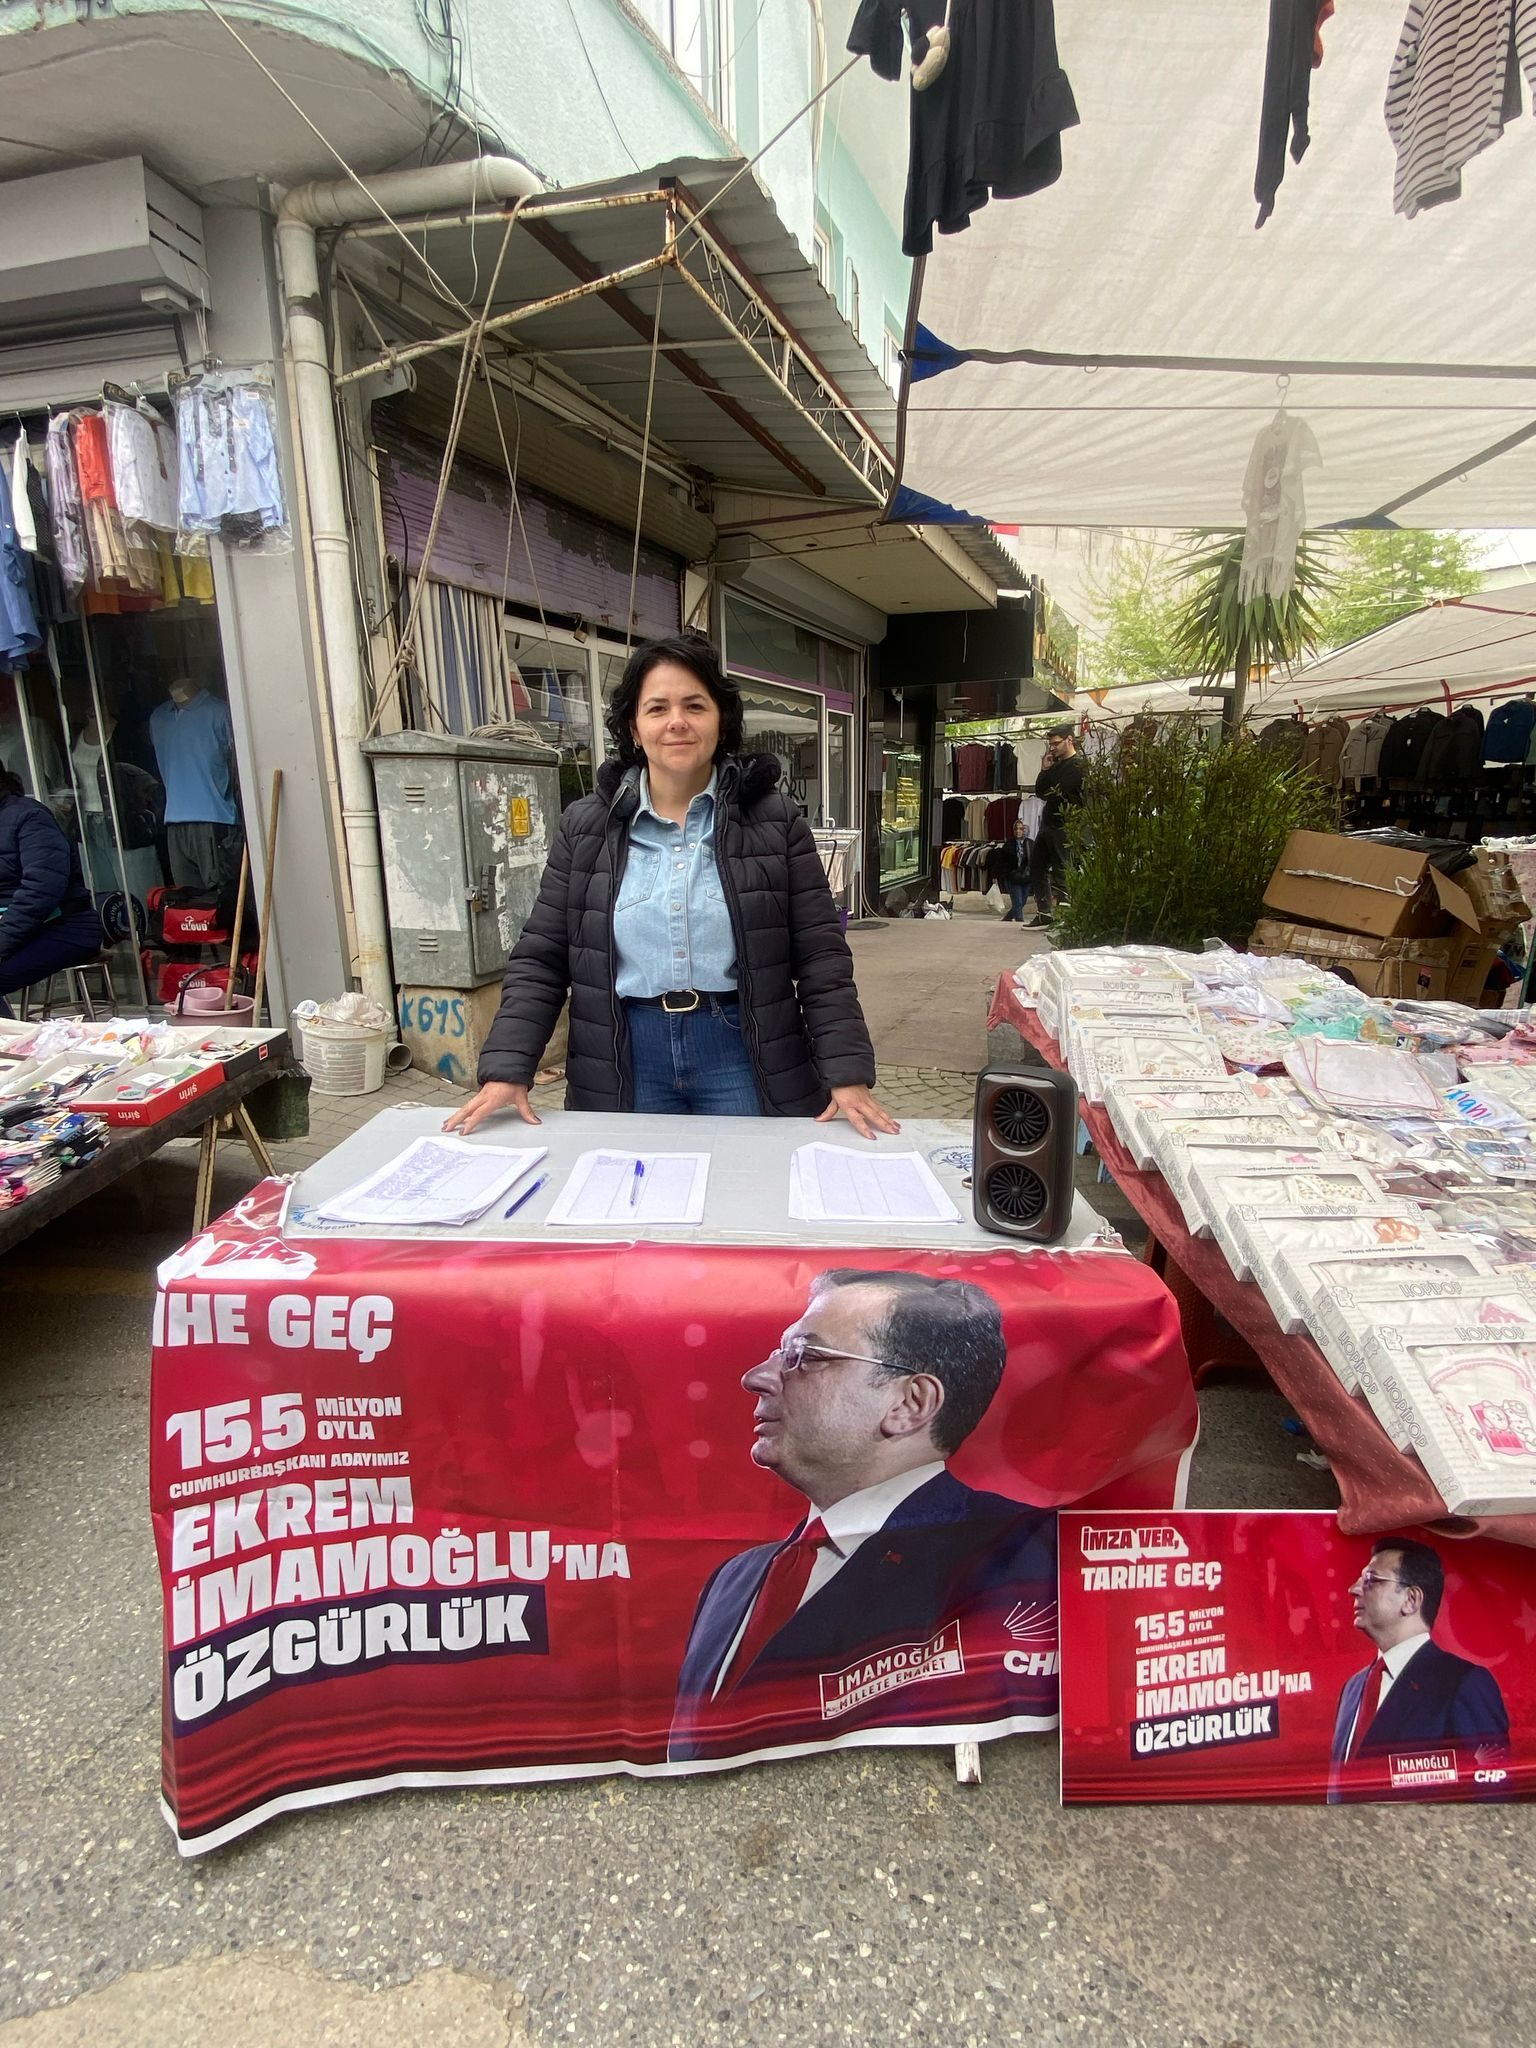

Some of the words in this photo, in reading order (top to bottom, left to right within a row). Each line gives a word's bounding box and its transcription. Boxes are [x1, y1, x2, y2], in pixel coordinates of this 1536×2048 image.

[181, 922, 208, 931] CLOUD
[178, 979, 206, 988] COUD
[268, 1294, 394, 1363] GEÇ
[166, 1393, 305, 1470] 15,5
[317, 1417, 375, 1441] OYLA
[169, 1453, 327, 1500] CUMHURBAŞKANI
[330, 1450, 410, 1469] ADAYIMIZ
[171, 1476, 415, 1573] EKREM
[1082, 1527, 1134, 1551] İMZA
[1138, 1527, 1180, 1550] VER,
[1174, 1561, 1222, 1591] GEÇ
[1134, 1609, 1186, 1642] 15,5
[1188, 1621, 1213, 1632] OYLA
[173, 1594, 530, 1722] ÖZGÜRLÜK
[838, 1634, 945, 1696] İMAMOĞLU
[895, 1657, 946, 1683] EMANET
[1135, 1646, 1227, 1687] EKREM
[1134, 1705, 1272, 1754] ÖZGÜRLÜK
[1397, 1755, 1449, 1773] İMAMOĞLU
[1474, 1769, 1507, 1784] CHP
